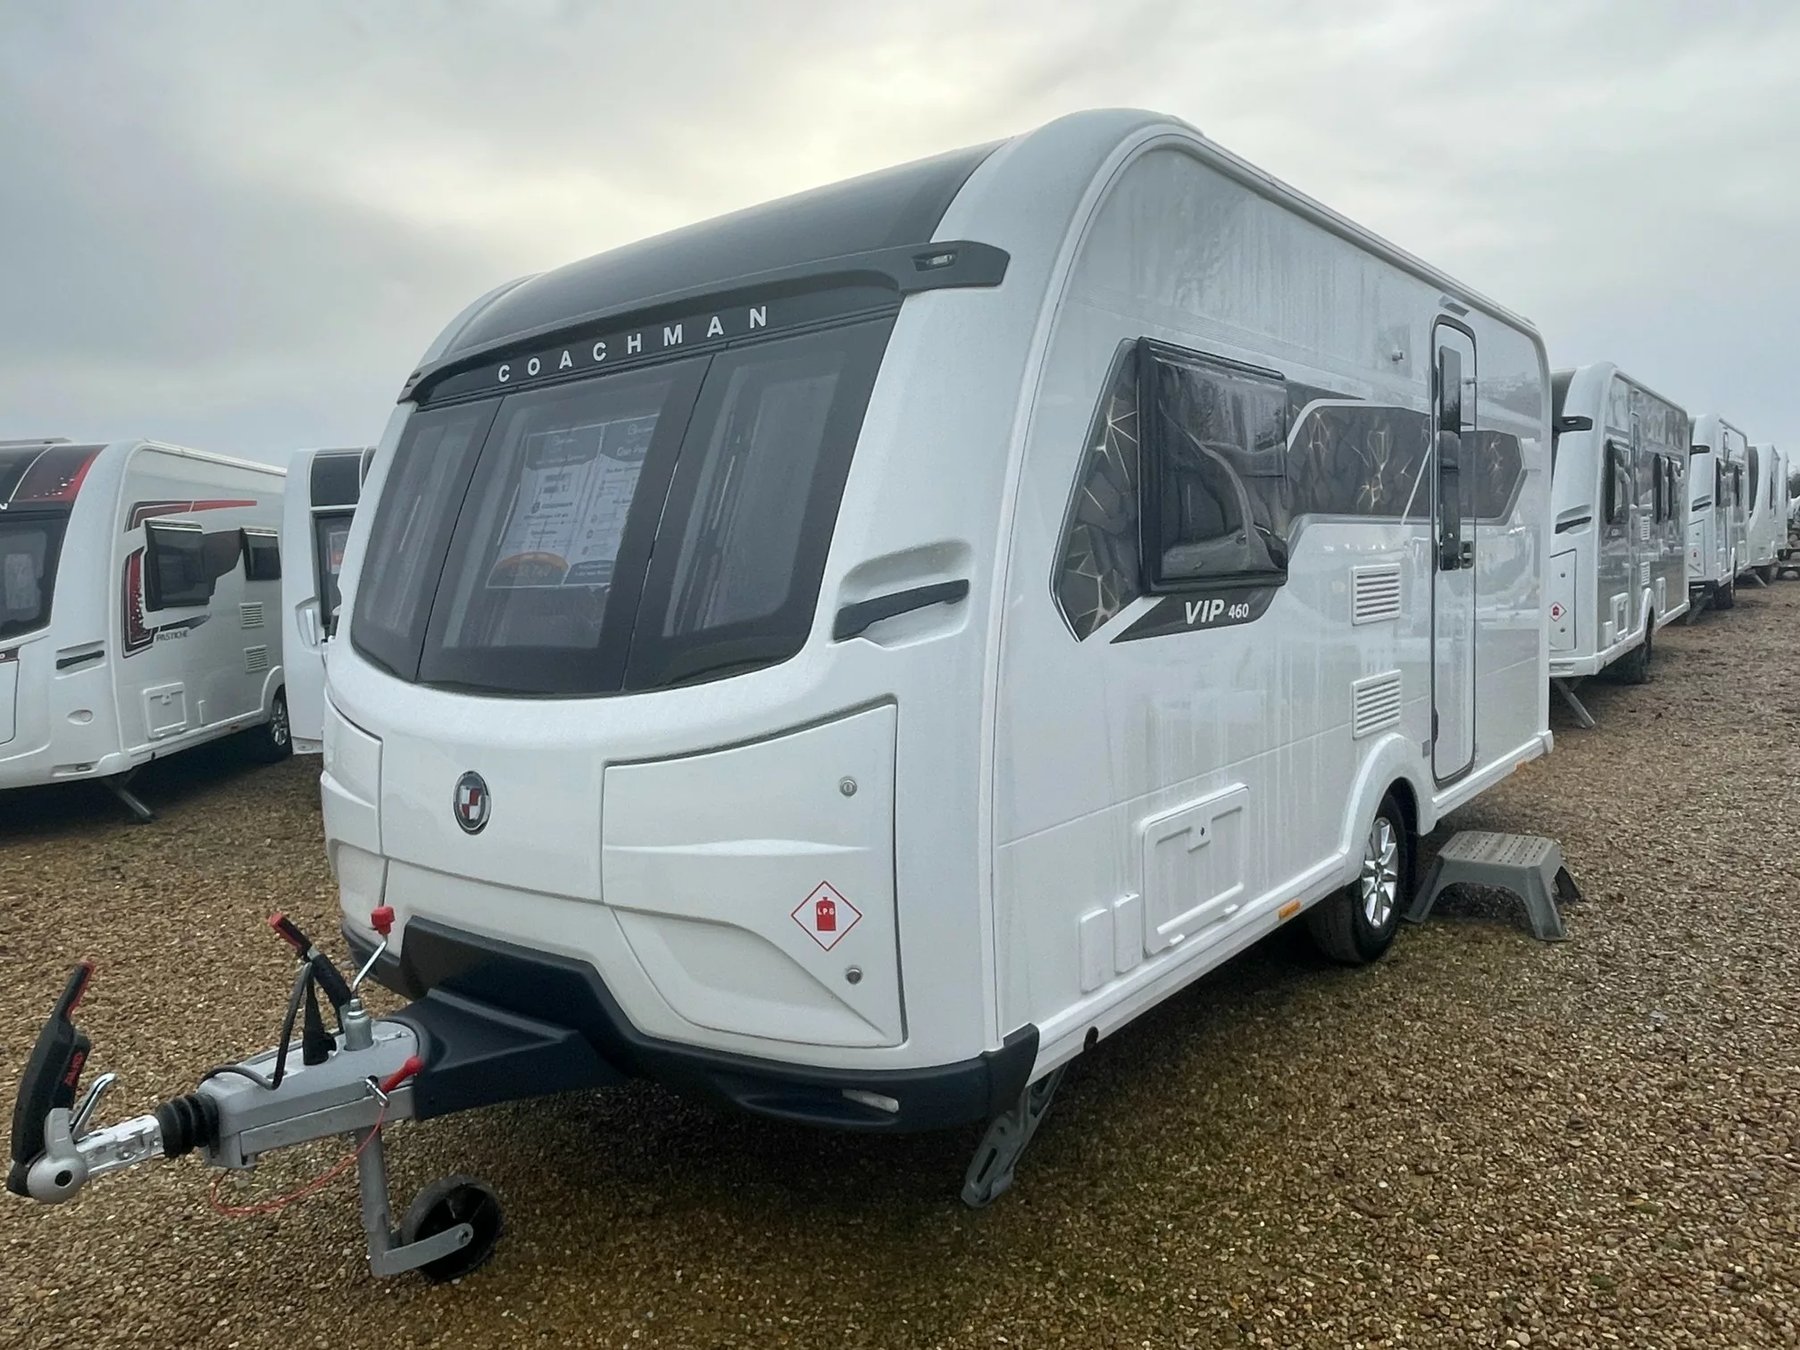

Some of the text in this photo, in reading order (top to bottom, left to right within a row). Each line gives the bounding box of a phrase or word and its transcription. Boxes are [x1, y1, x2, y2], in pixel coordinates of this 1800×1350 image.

[498, 306, 767, 382] COACHMAN
[1185, 599, 1249, 625] VIP 460
